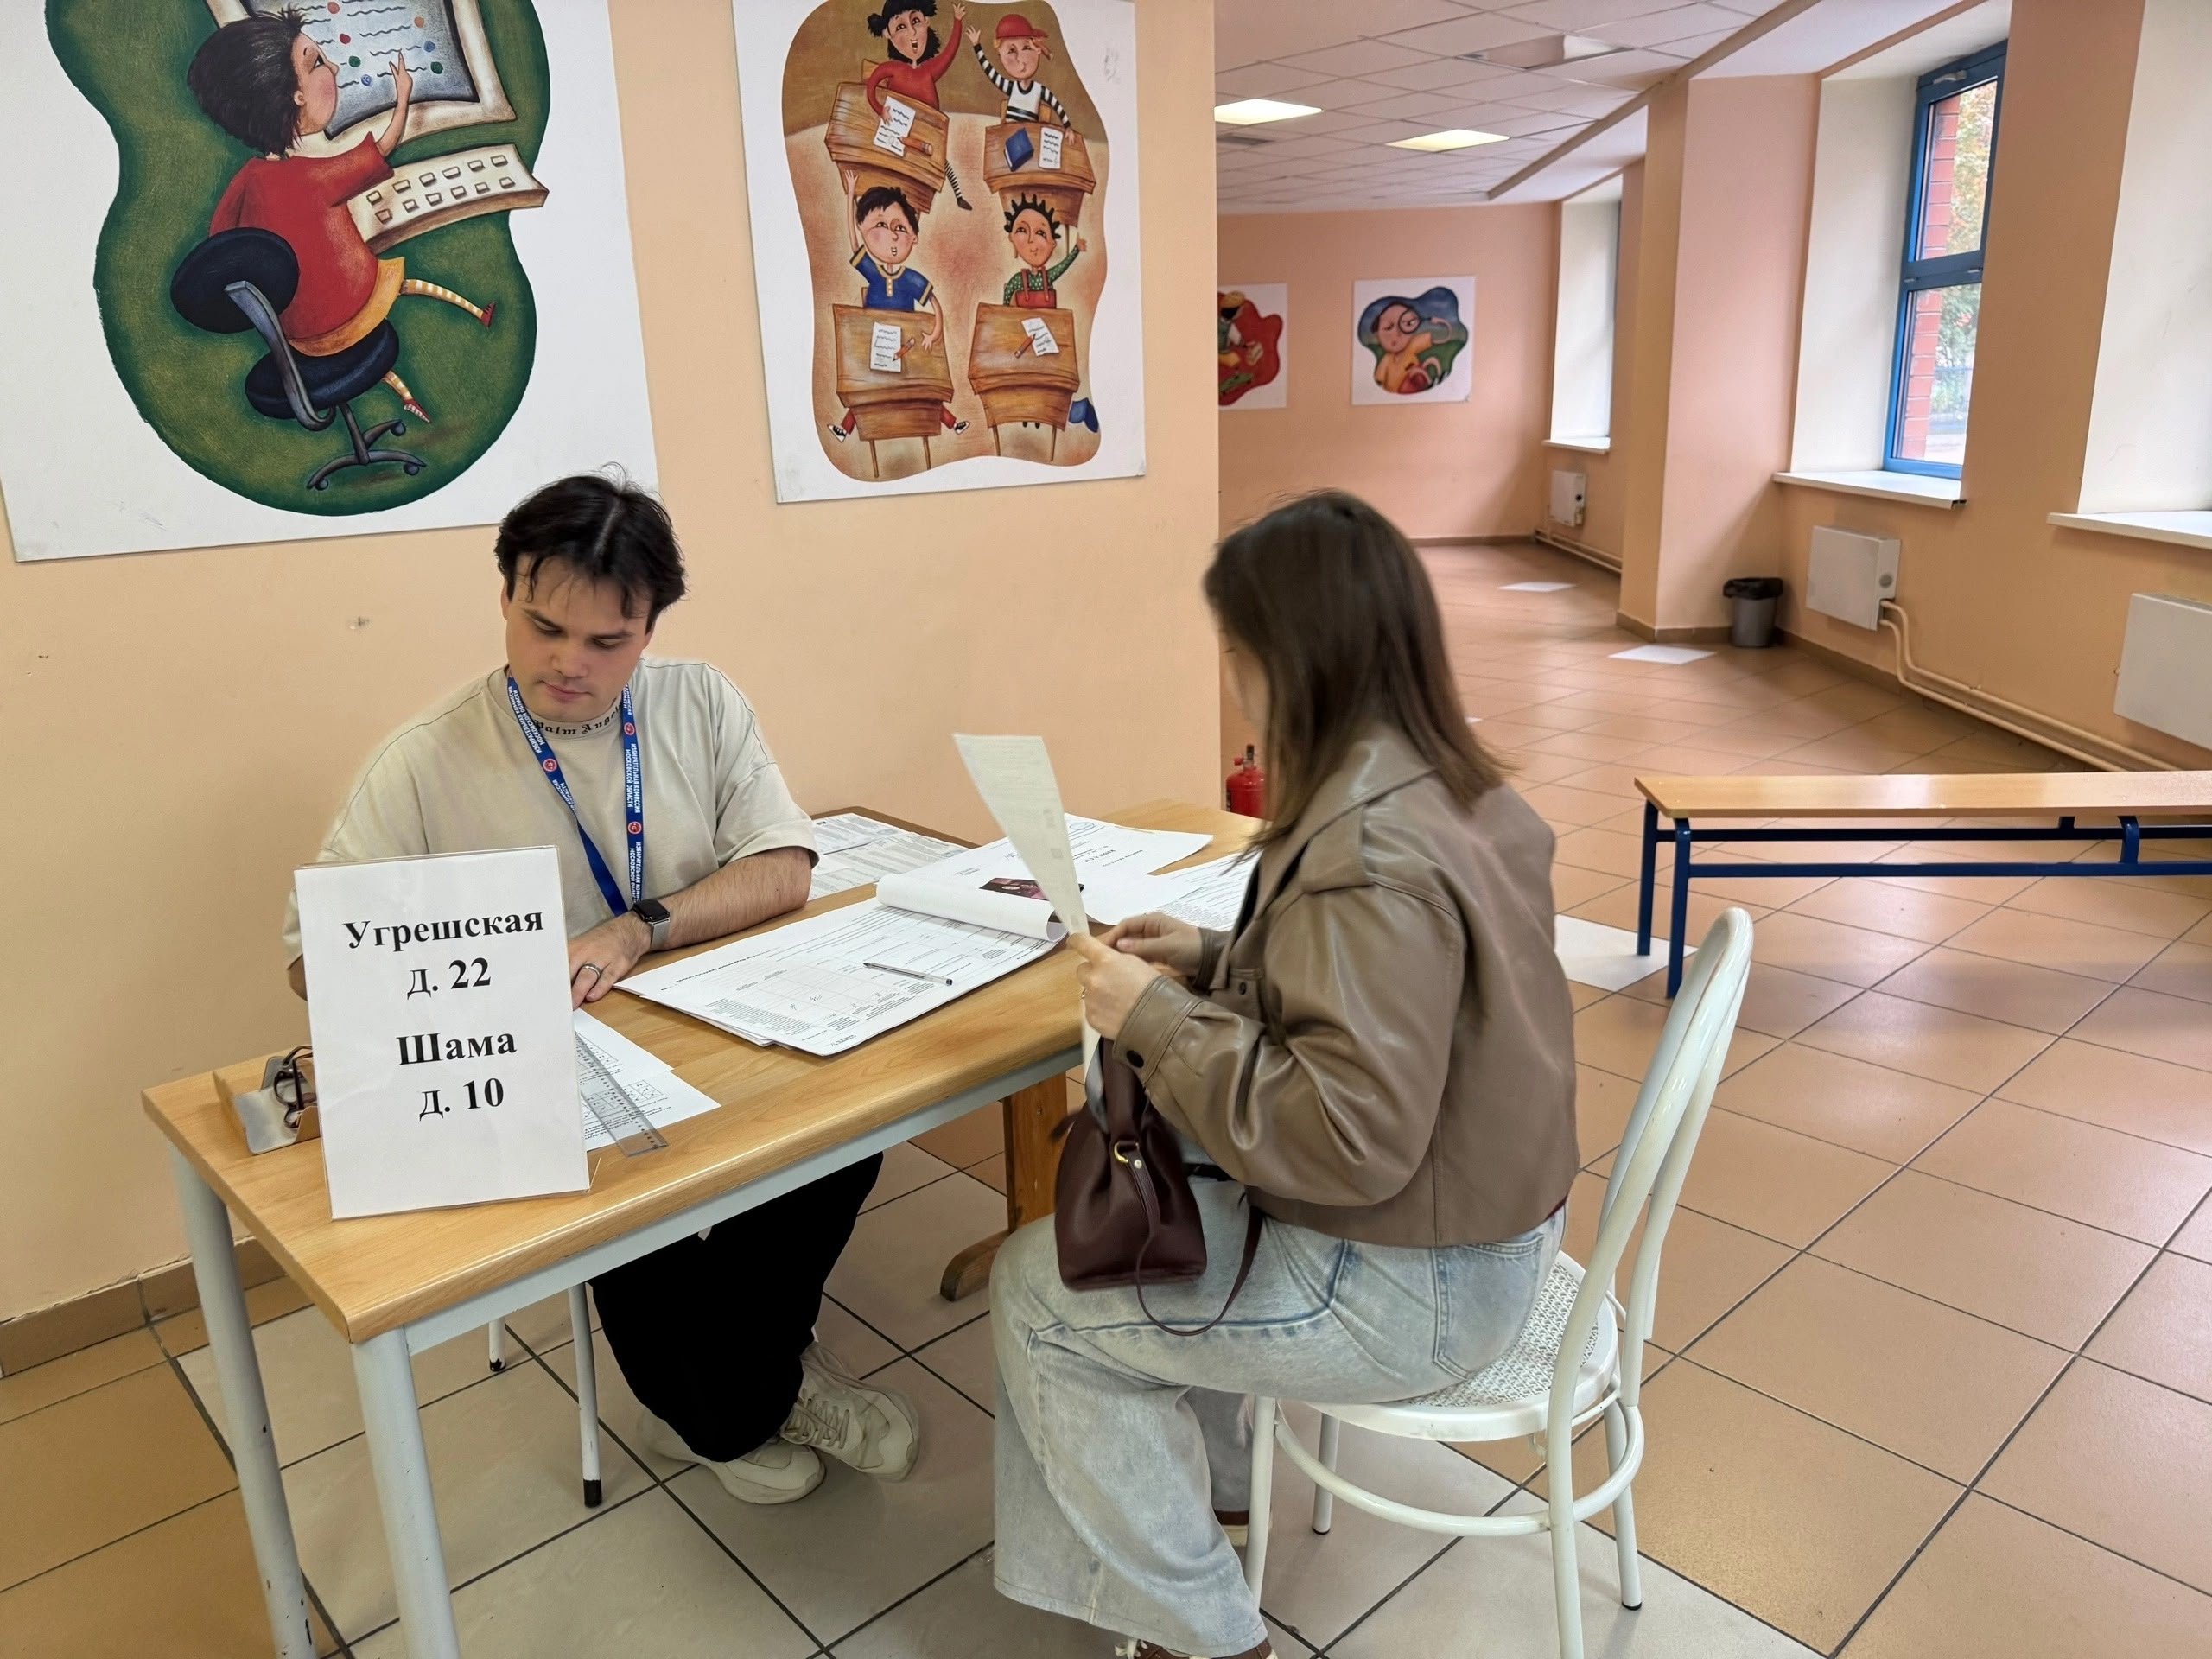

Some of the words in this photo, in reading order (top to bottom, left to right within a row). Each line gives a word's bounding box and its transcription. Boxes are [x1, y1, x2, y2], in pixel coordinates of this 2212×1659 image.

[508, 685, 520, 714] КОМИССИЯ
[513, 690, 526, 713] ОБЛАСТИ
[518, 714, 543, 754] ИЗБИРАТЕЛЬНАЯ
[522, 713, 545, 746] МОСКОВСКОЙ
[582, 704, 621, 734] Angel
[625, 749, 633, 783] МОСКОВСКОЙ
[631, 743, 639, 785] ИЗБИРАТЕЛЬНАЯ
[342, 912, 543, 952] Угрешская
[407, 969, 438, 1000] д.
[448, 957, 492, 989] 22
[396, 1033, 517, 1065] Шама
[419, 1090, 450, 1122] д.
[463, 1077, 504, 1109] 10
